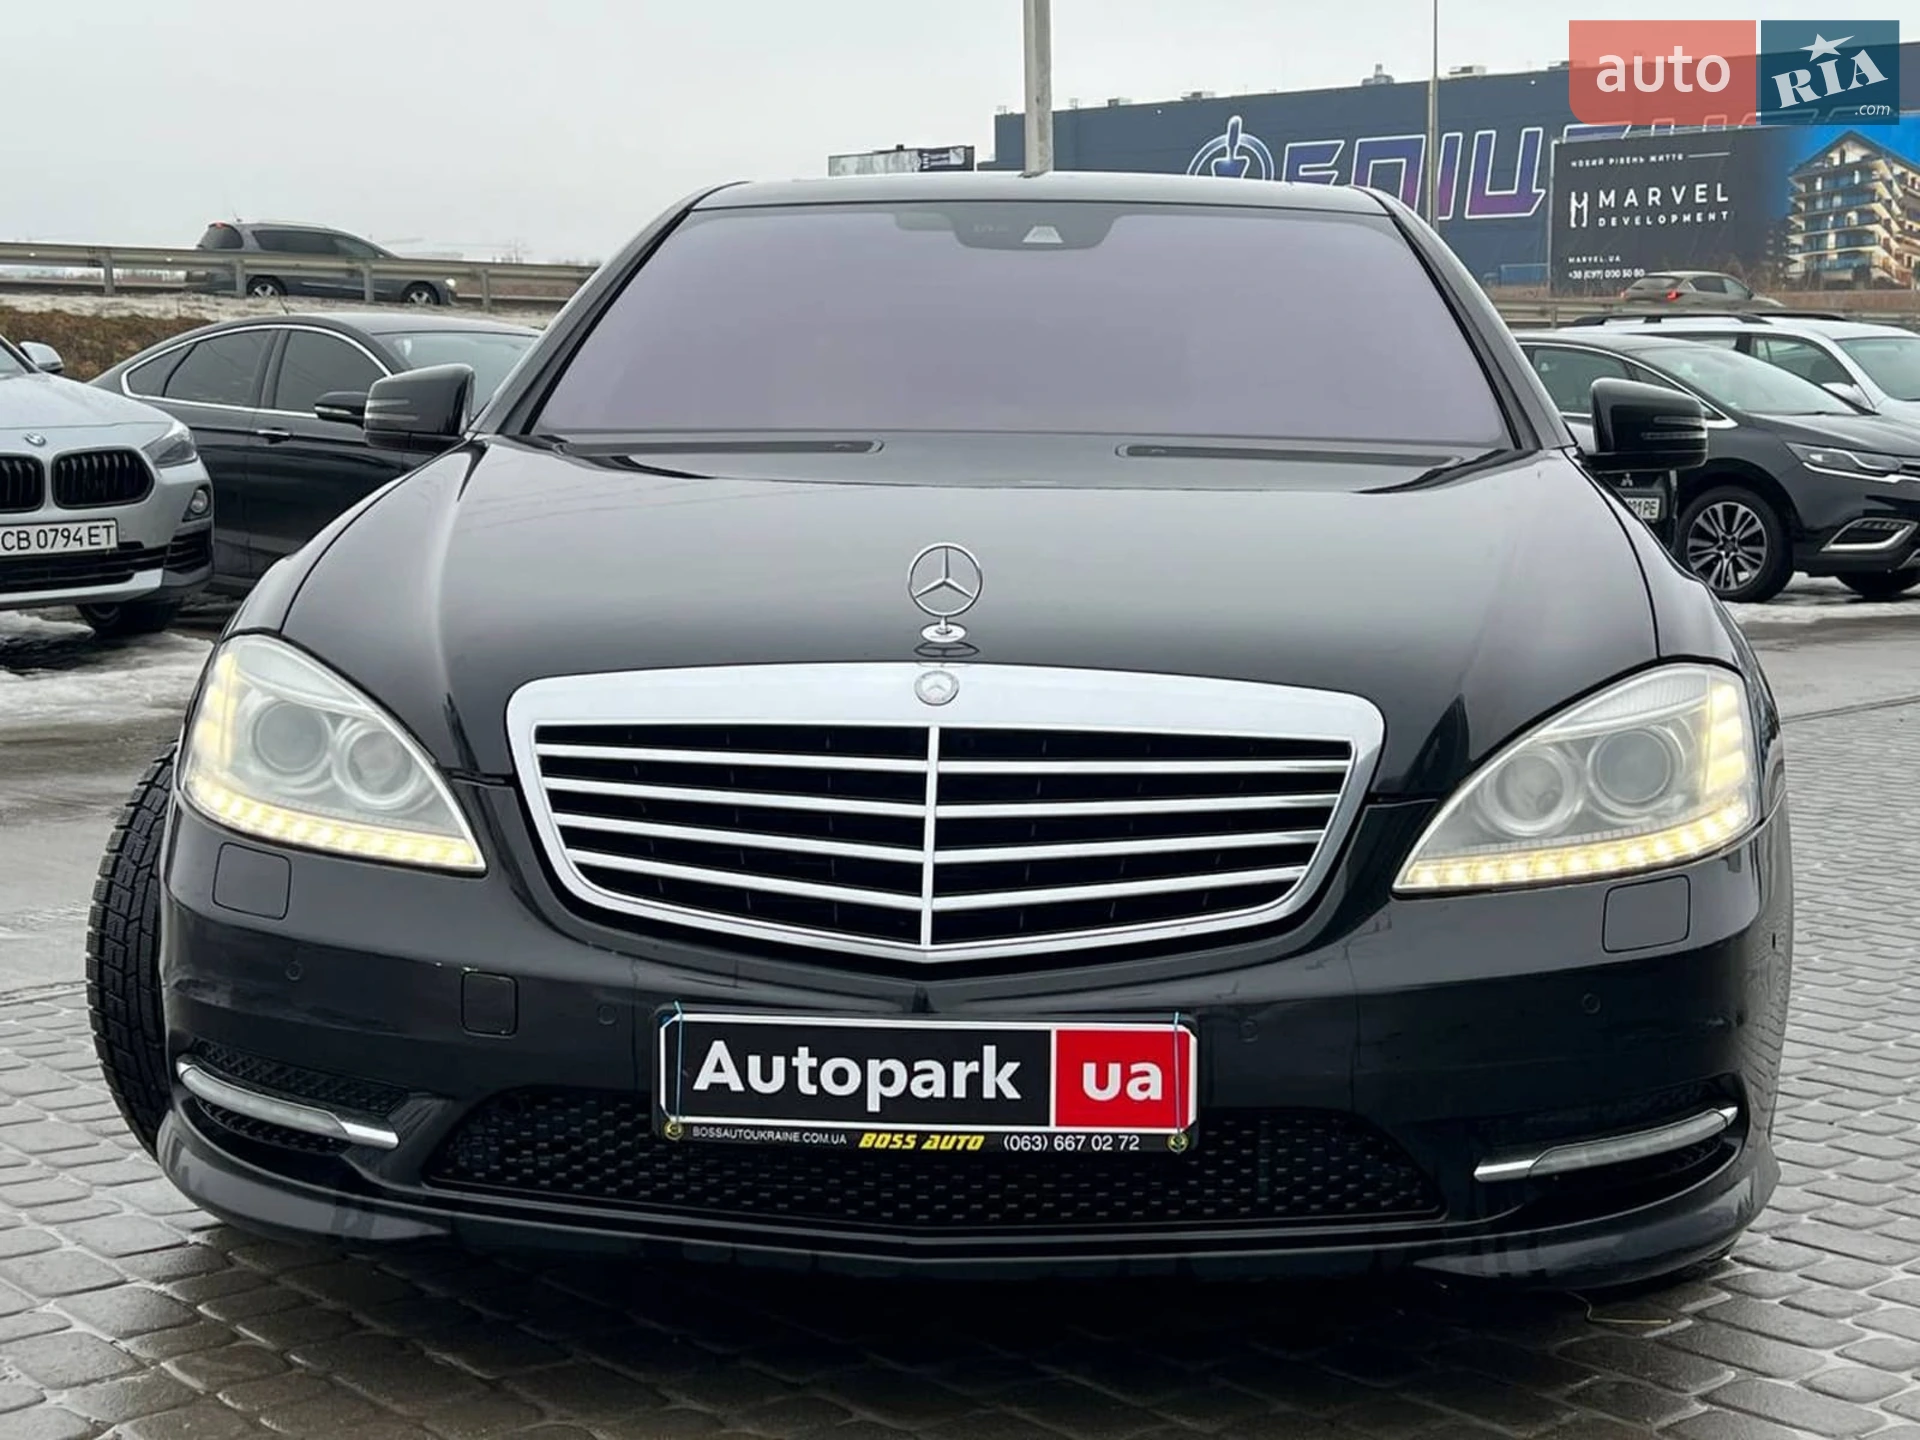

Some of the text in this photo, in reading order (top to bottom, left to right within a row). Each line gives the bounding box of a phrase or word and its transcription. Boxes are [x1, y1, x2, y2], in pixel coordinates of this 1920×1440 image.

[1599, 183, 1729, 208] MARVEL
[1599, 210, 1729, 227] DEVELOPMENT
[1, 525, 115, 551] CB 0794 ET
[693, 1040, 1163, 1113] Autopark ua
[858, 1132, 917, 1149] BOSS
[1003, 1134, 1048, 1151] (063)
[1053, 1135, 1085, 1151] 667
[1091, 1135, 1113, 1151] 02
[1118, 1135, 1140, 1151] 72
